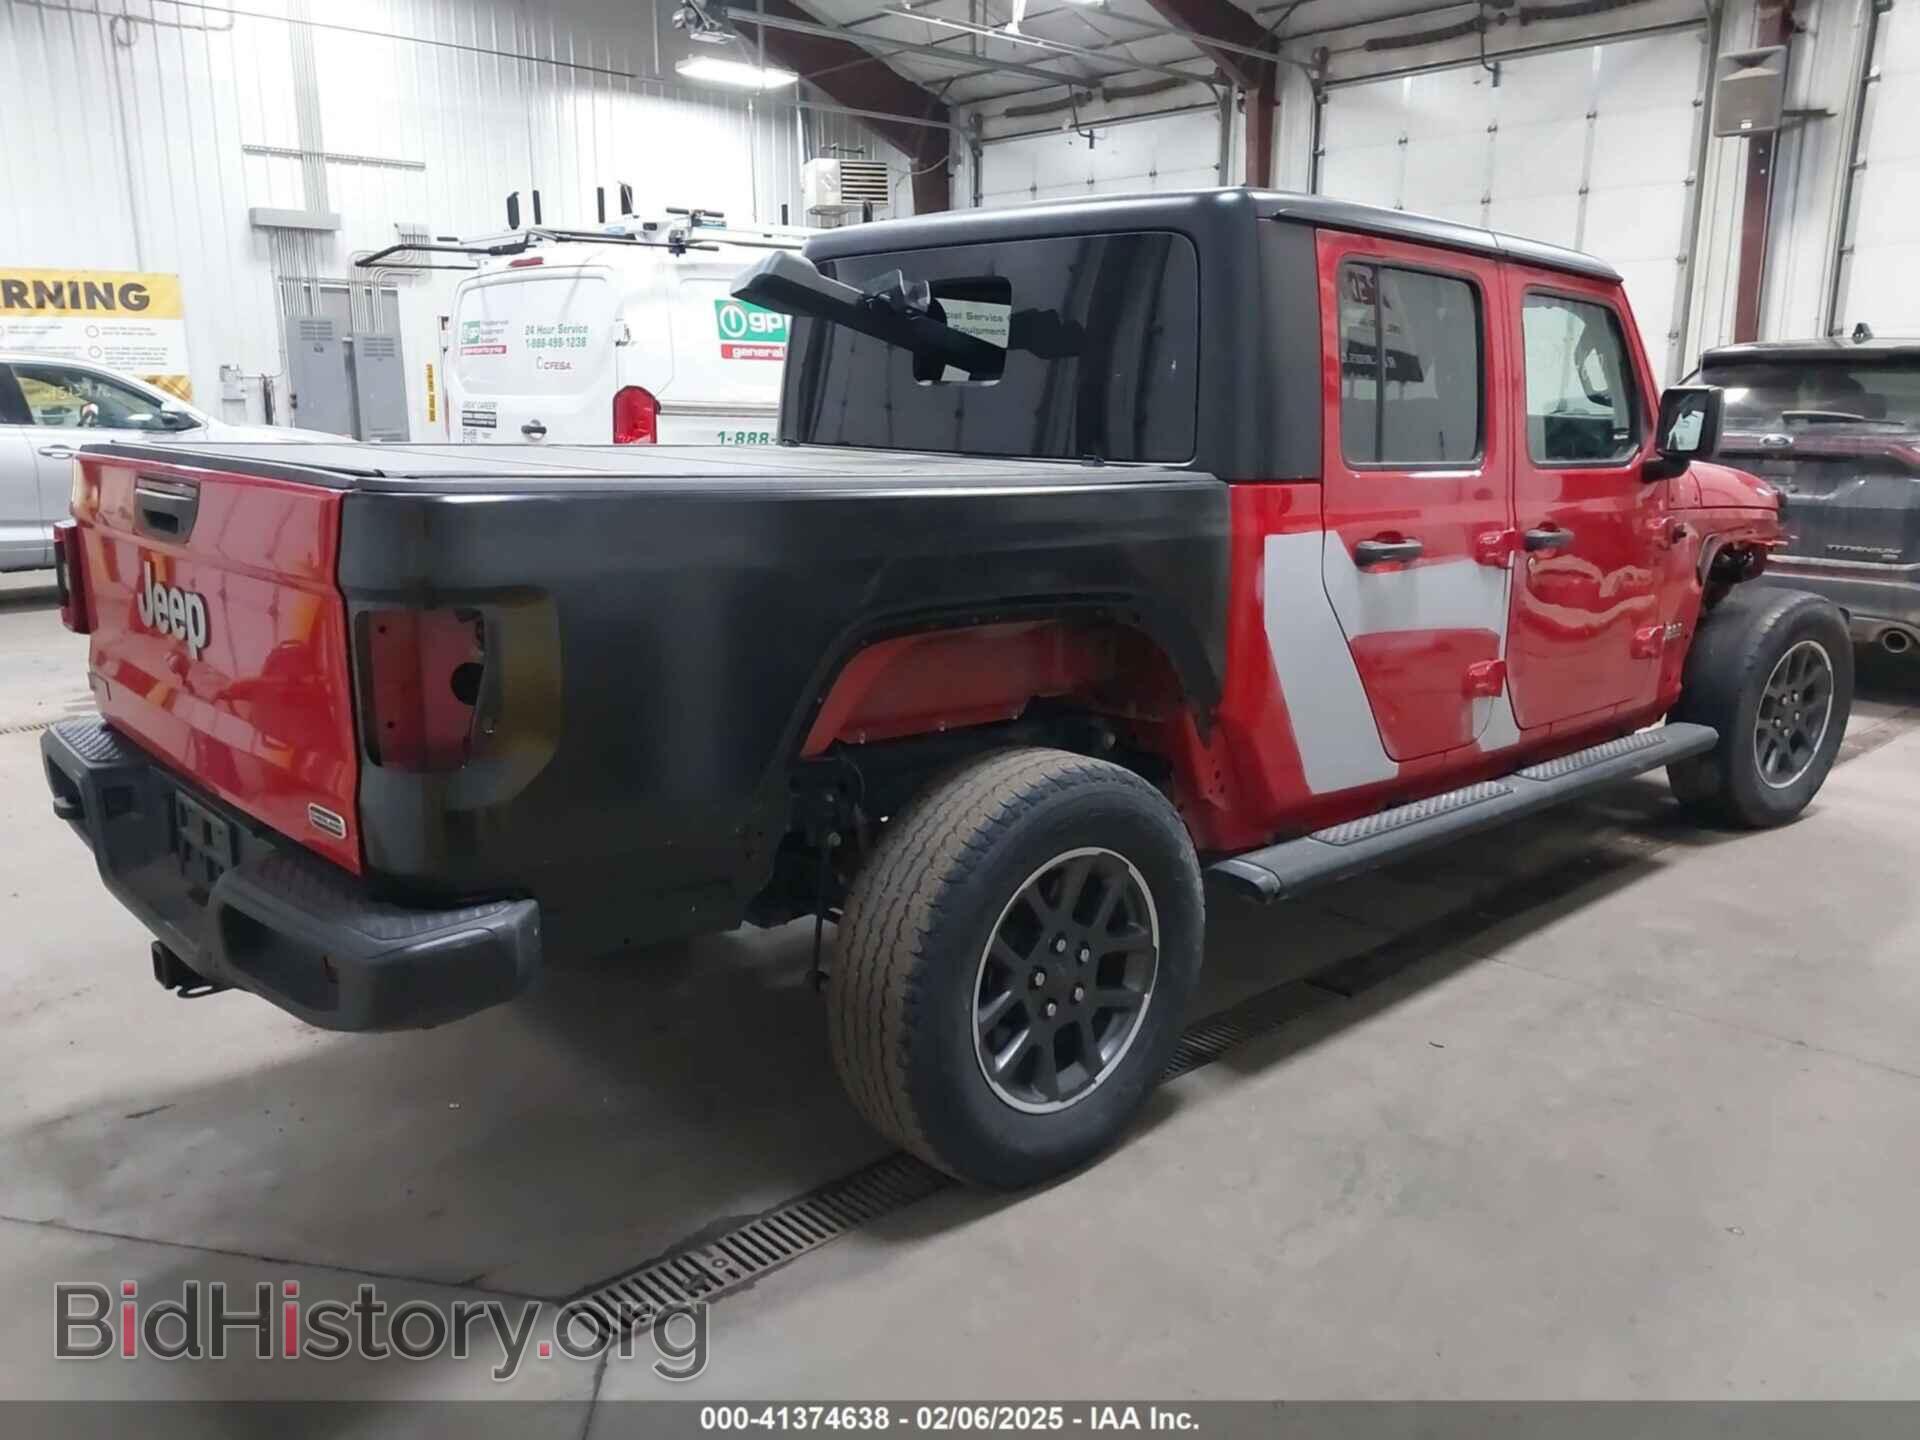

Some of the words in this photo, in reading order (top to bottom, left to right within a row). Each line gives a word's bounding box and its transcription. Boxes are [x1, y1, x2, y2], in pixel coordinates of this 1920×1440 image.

[0, 279, 151, 311] RNING
[966, 311, 1003, 322] Service
[525, 325, 534, 336] 24
[537, 325, 555, 335] Hour
[558, 323, 588, 335] Service
[137, 561, 207, 662] Jeep
